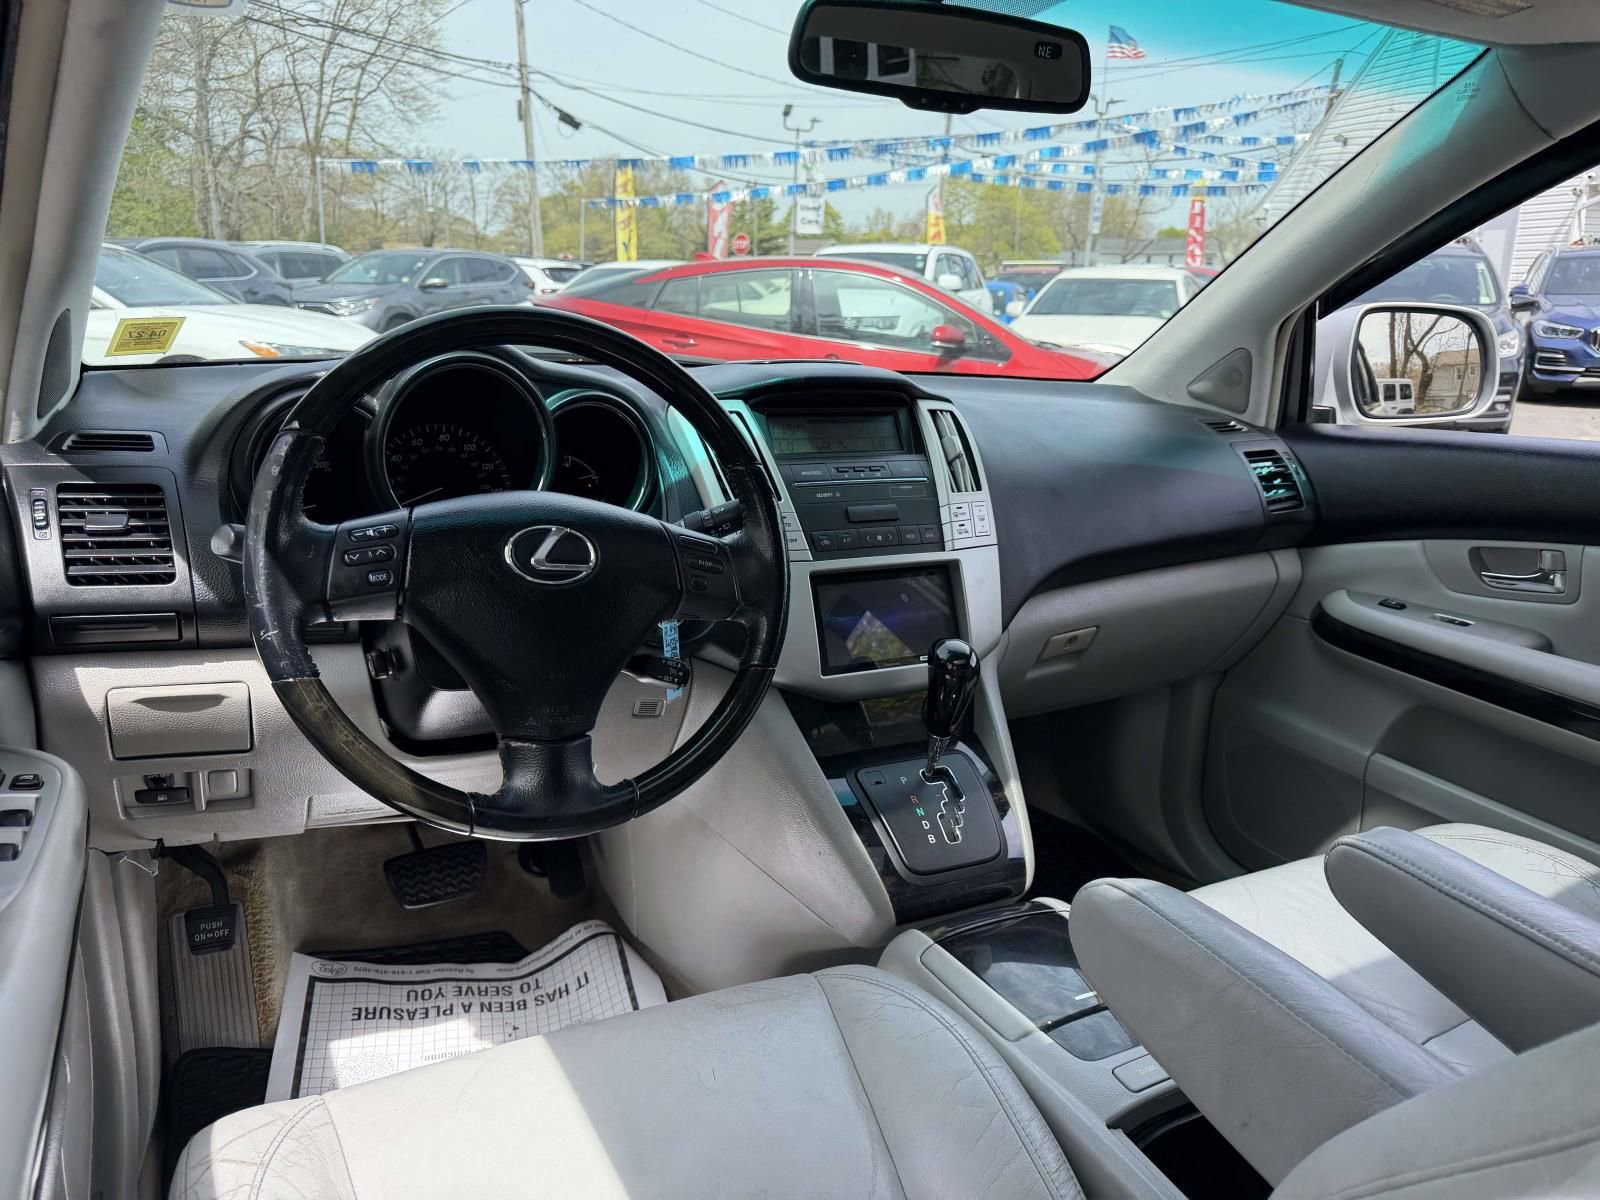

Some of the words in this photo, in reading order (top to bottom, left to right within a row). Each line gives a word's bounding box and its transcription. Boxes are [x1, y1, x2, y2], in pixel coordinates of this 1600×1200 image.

[1038, 45, 1052, 58] NE
[368, 573, 388, 582] MODE
[900, 776, 907, 784] P
[910, 795, 919, 804] R
[916, 807, 925, 816] N
[922, 820, 930, 829] D
[927, 834, 936, 844] B
[200, 920, 223, 930] PUSH
[194, 932, 206, 942] ON
[214, 928, 230, 938] OFF
[519, 978, 542, 993] TO
[574, 971, 590, 990] IT
[406, 986, 445, 1003] YOU
[452, 983, 513, 998] SERVE
[534, 982, 569, 1006] HAS
[351, 1003, 453, 1021] PLEASURE
[459, 1001, 473, 1015] A
[479, 998, 527, 1014] BEEN
